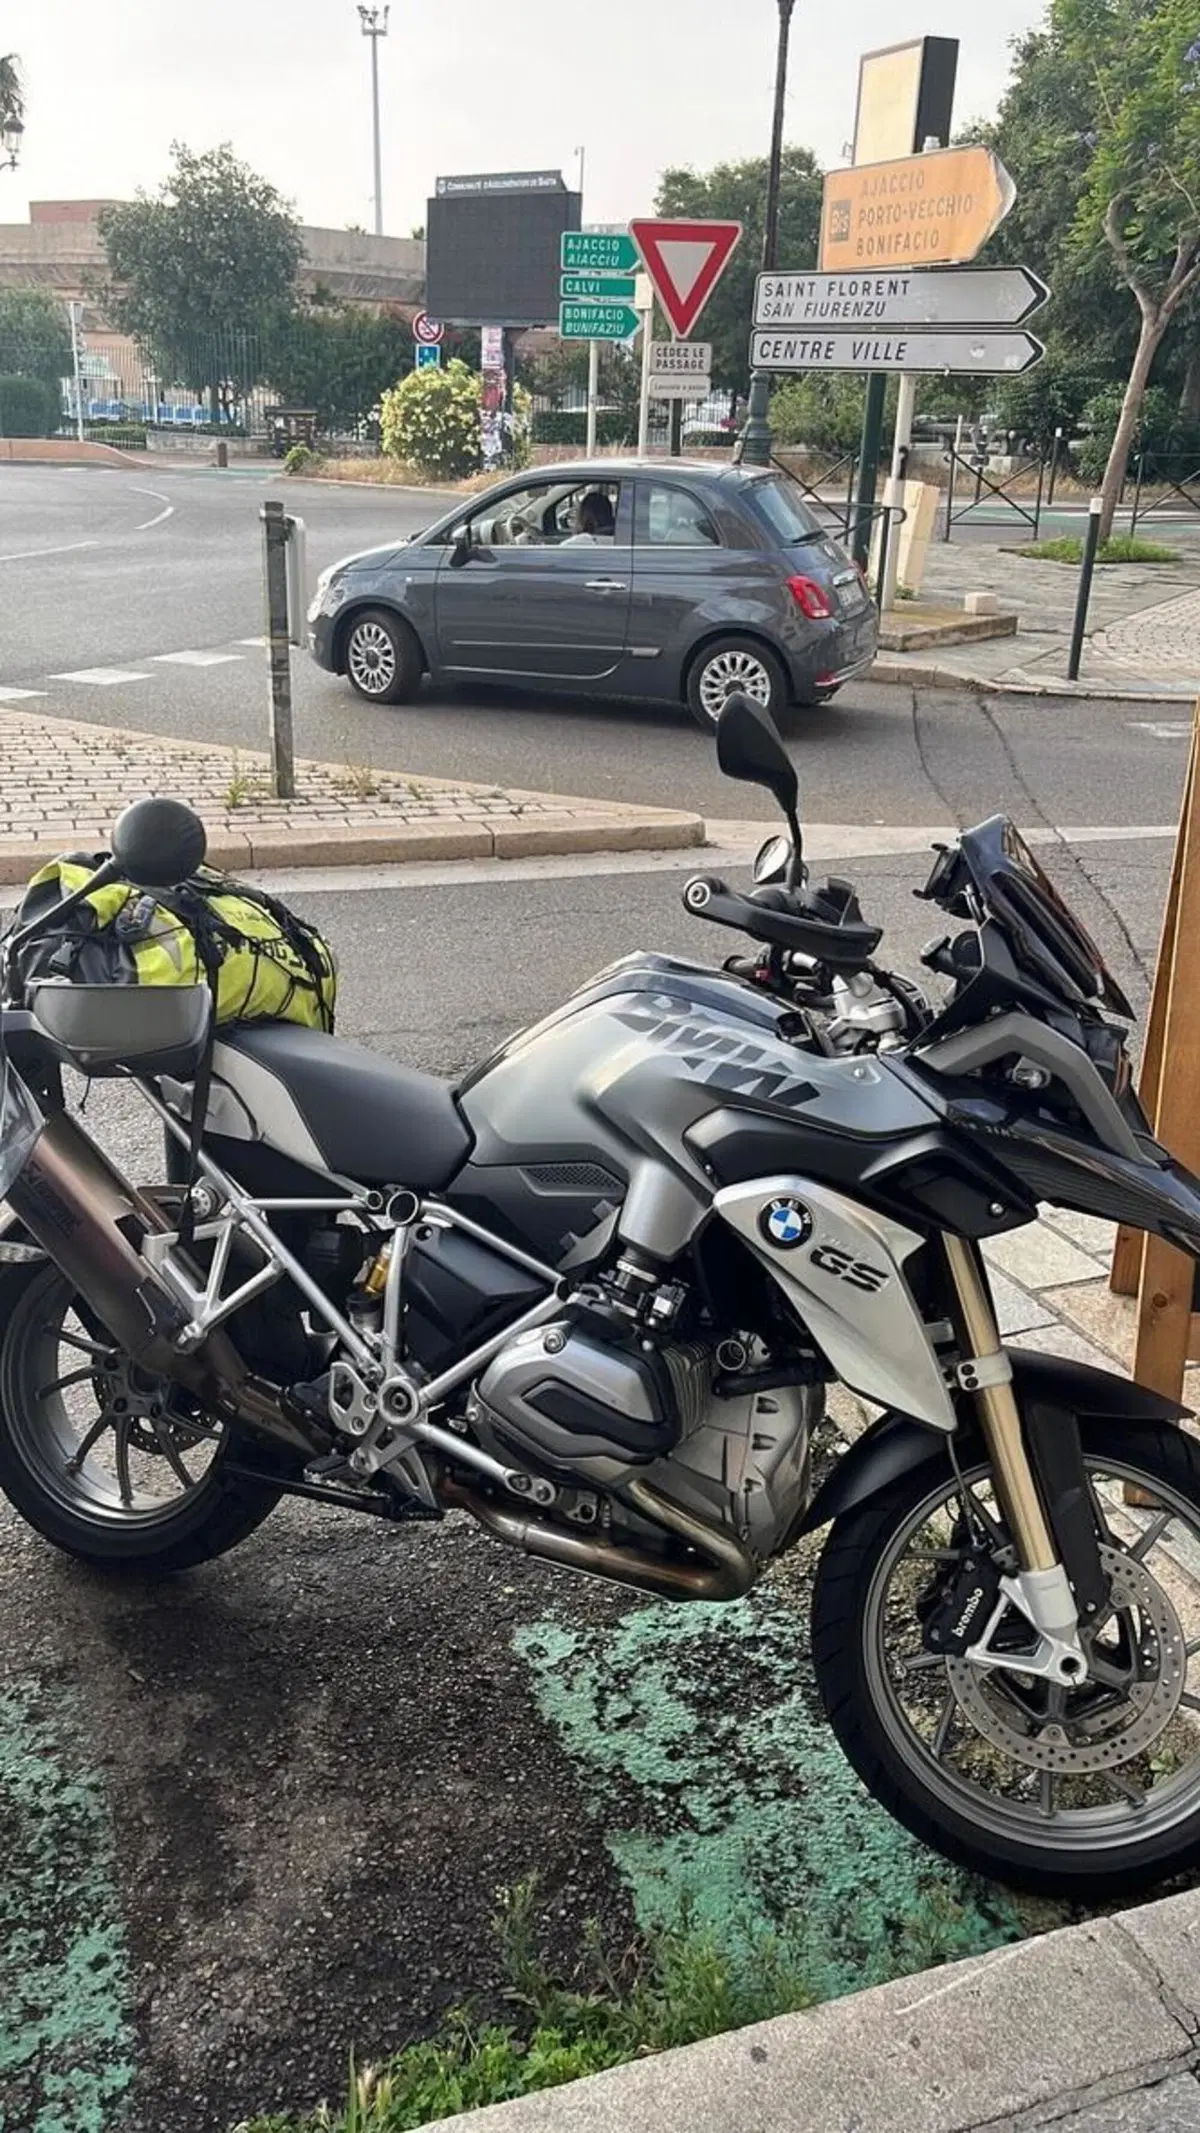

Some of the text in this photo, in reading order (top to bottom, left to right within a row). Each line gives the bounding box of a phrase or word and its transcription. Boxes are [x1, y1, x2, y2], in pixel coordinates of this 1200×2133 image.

[860, 169, 924, 197] AJACCIO
[858, 195, 973, 225] PORTO-VECCHIO
[567, 239, 620, 251] AJACCIO
[856, 229, 939, 257] BONIFACIO
[567, 254, 620, 266] AIACCIU
[566, 281, 600, 293] CALVI
[764, 280, 910, 297] SAINT FLORENT
[565, 308, 624, 320] BONIFACIO
[762, 301, 886, 318] SAN FIURENZU
[565, 322, 626, 334] BUNIFAZIU
[656, 346, 705, 358] CÉDEZ LE
[759, 340, 907, 361] CENTRE VILLE
[656, 359, 705, 370] PASSAGE
[810, 1245, 889, 1292] GS
[952, 1588, 982, 1637] brembo
